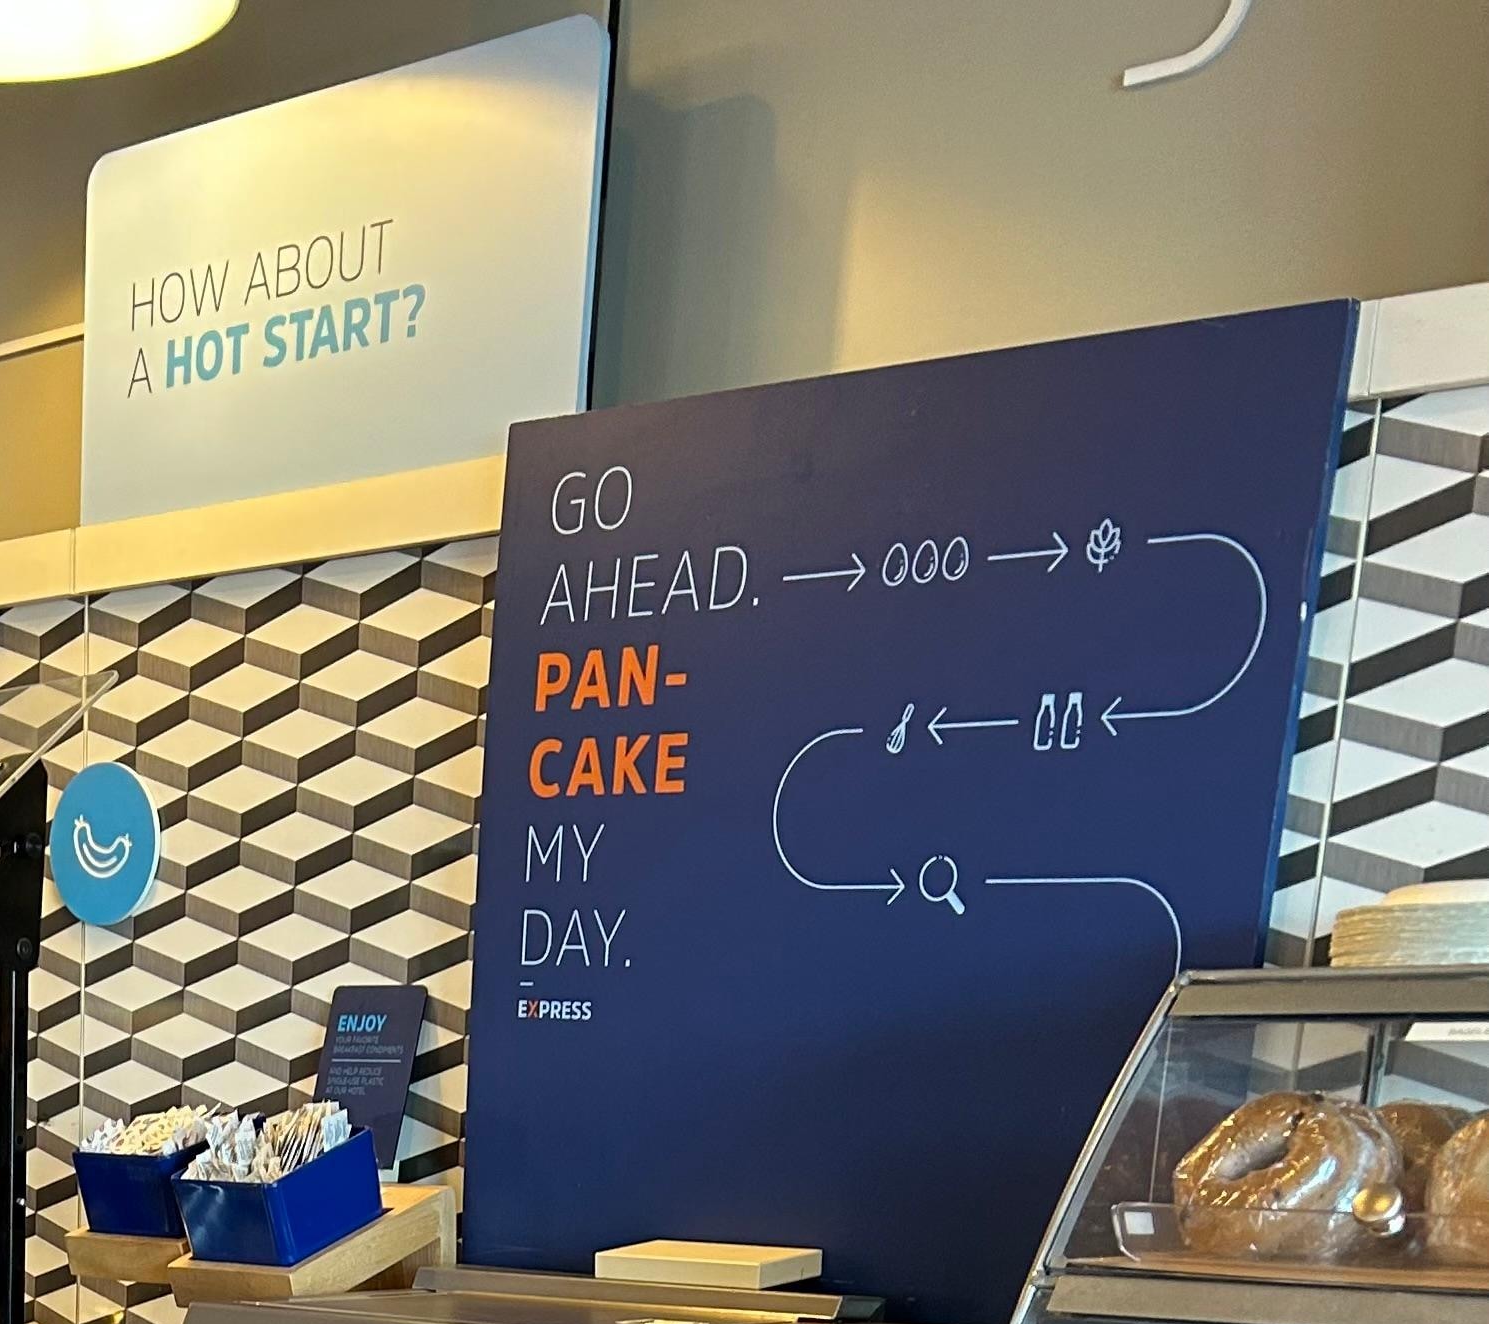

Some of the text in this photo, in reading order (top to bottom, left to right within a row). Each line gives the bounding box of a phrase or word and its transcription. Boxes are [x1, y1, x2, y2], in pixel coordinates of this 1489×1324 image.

[131, 218, 394, 332] HOW ABOUT
[127, 284, 426, 399] A HOT START?
[552, 466, 633, 535] GO
[540, 546, 759, 625] AHEAD.
[535, 645, 687, 712] PAN-
[529, 733, 689, 798] CAKE
[525, 823, 605, 882] MY
[521, 909, 631, 967] DAY.
[338, 1015, 387, 1032] ENJOY
[518, 1000, 592, 1020] EXPRESS
